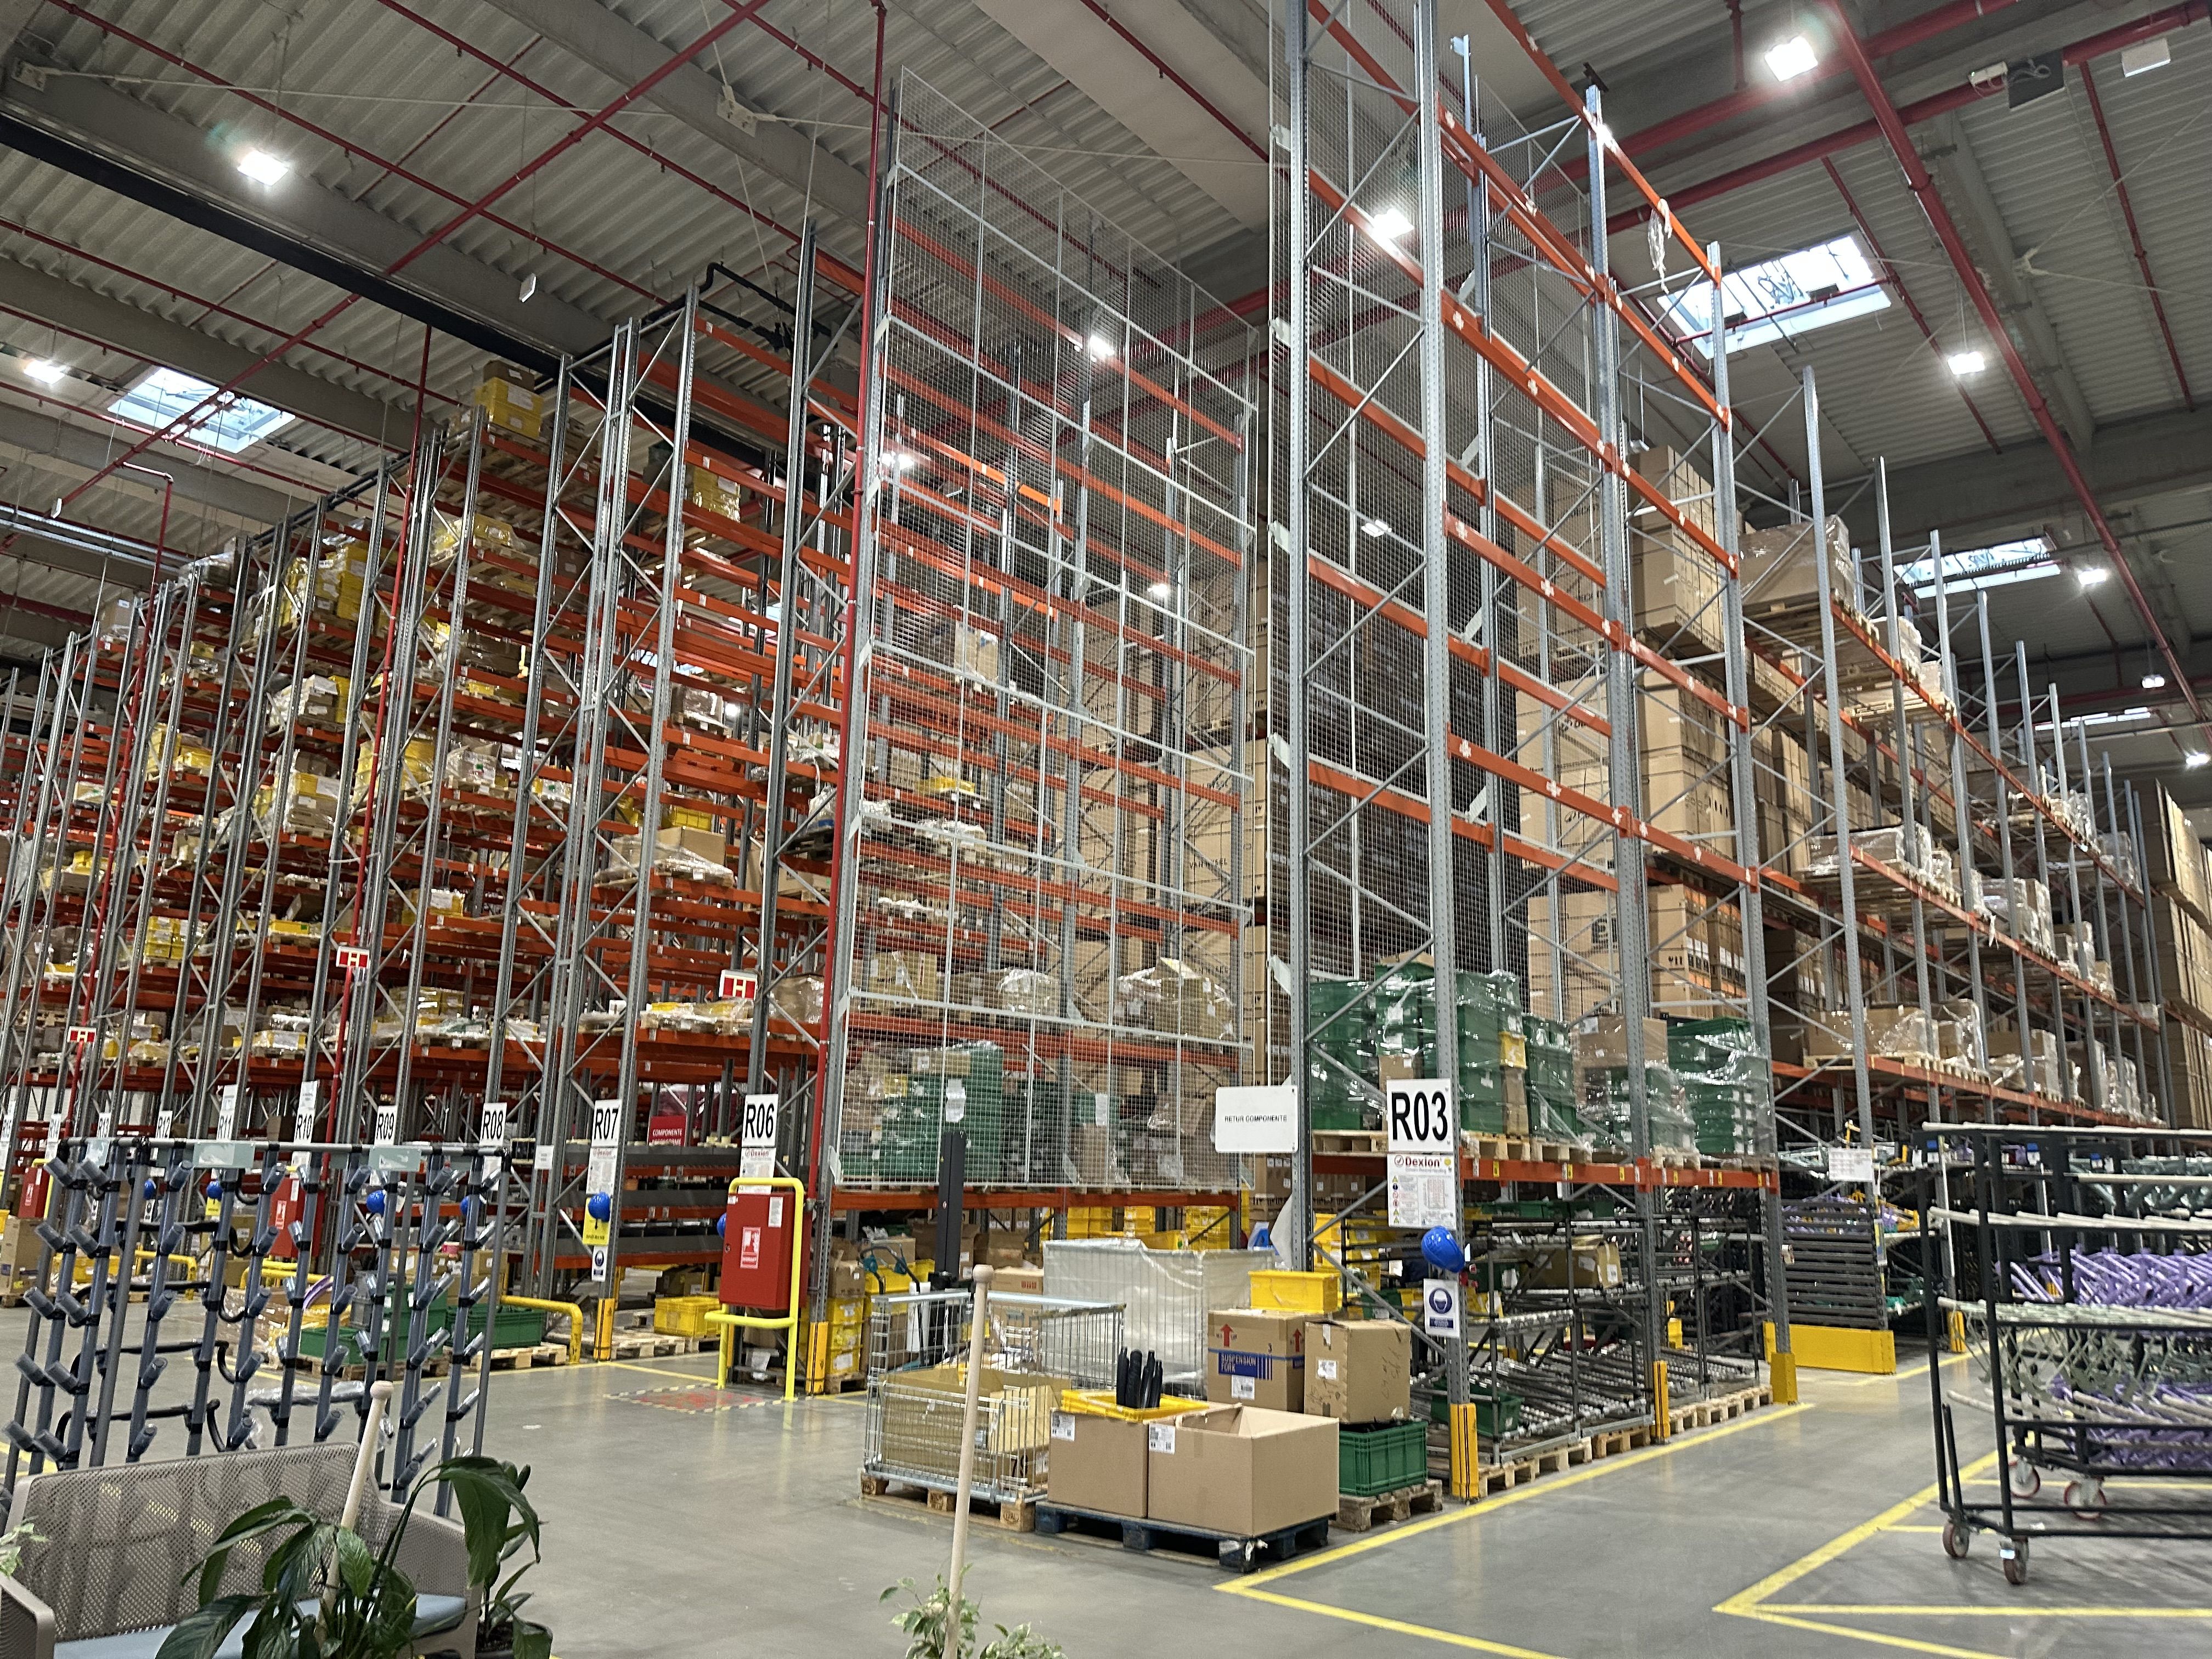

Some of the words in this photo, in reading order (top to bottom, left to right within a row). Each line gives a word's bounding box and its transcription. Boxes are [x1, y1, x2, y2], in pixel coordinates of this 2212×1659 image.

[347, 952, 360, 967] H
[732, 978, 747, 998] H
[77, 1030, 88, 1042] H
[482, 1110, 504, 1139] R08
[594, 1107, 619, 1139] R07
[744, 1103, 775, 1138] R06
[1245, 1114, 1287, 1122] COMPONENTE
[1392, 1090, 1448, 1141] R03
[97, 1118, 109, 1138] R13
[156, 1116, 170, 1138] R12
[218, 1114, 232, 1139] R11
[296, 1114, 312, 1139] R10
[376, 1113, 394, 1140] R09
[653, 1128, 682, 1137] COMPONENTE
[1405, 1156, 1440, 1167] Dexion
[1221, 1353, 1256, 1366] SUSPENSION
[1221, 1362, 1235, 1373] FORK
